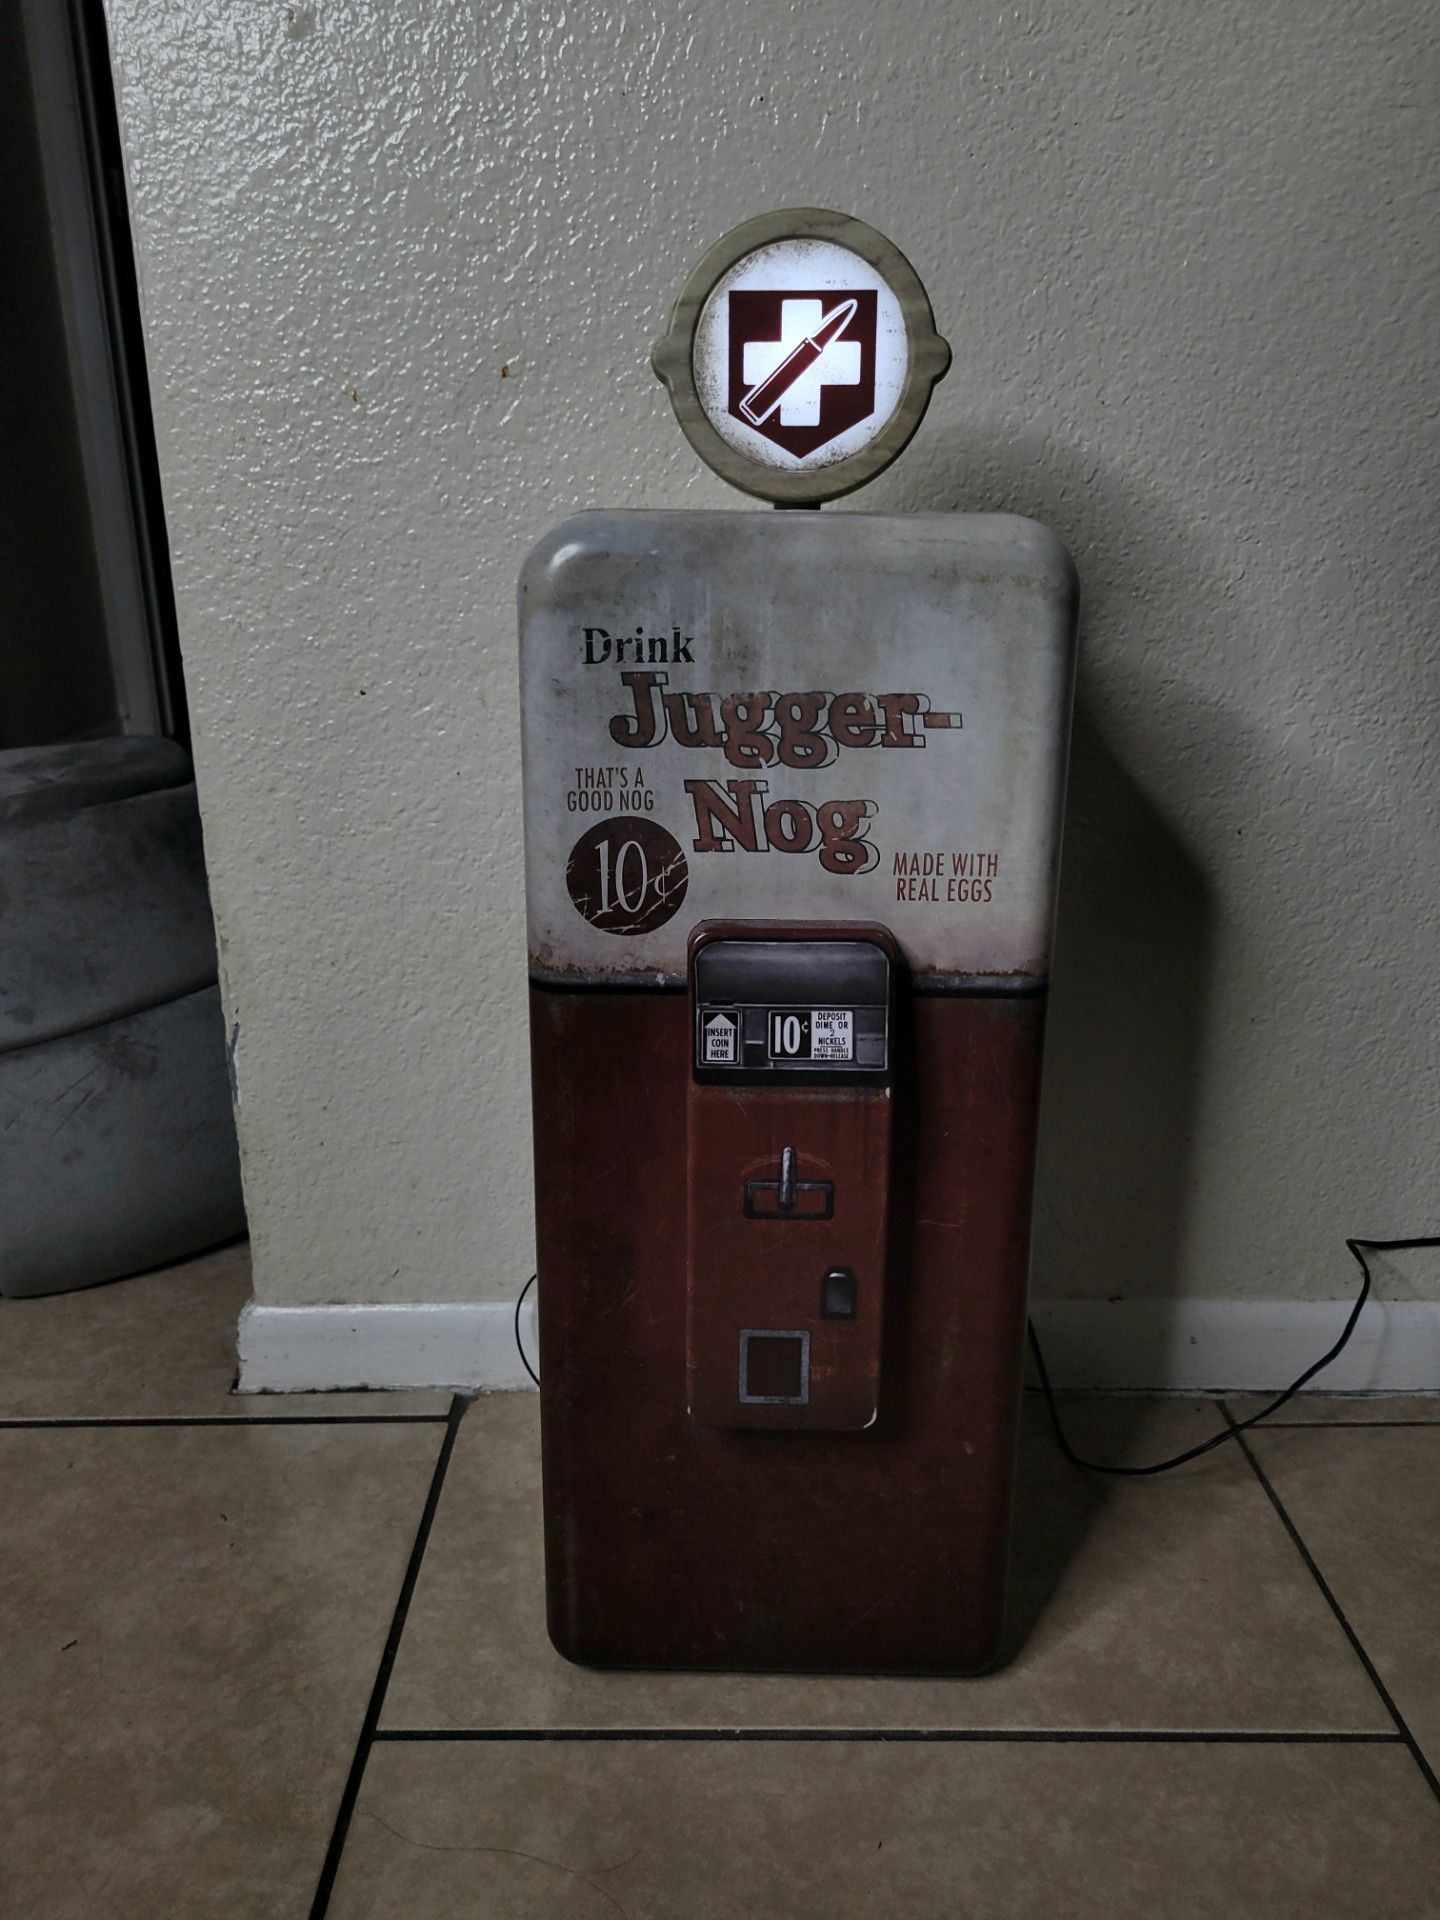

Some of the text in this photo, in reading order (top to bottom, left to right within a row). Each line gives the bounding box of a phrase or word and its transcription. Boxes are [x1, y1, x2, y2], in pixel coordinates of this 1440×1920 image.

[582, 626, 696, 665] Drink
[608, 671, 963, 769] Jugger-
[575, 767, 645, 789] THAT'S A
[566, 791, 654, 812] GOOD NOG
[684, 779, 880, 875] Nog
[892, 853, 999, 877] MADE WITH
[895, 879, 993, 902] REAL EGGS
[817, 1012, 846, 1021] DEPOSIT
[708, 1028, 732, 1037] INSERT
[815, 1021, 848, 1029] DIME OR
[829, 1029, 835, 1037] 2
[711, 1039, 729, 1048] COIN
[818, 1037, 846, 1046] NICKELS
[711, 1050, 729, 1059] HERE
